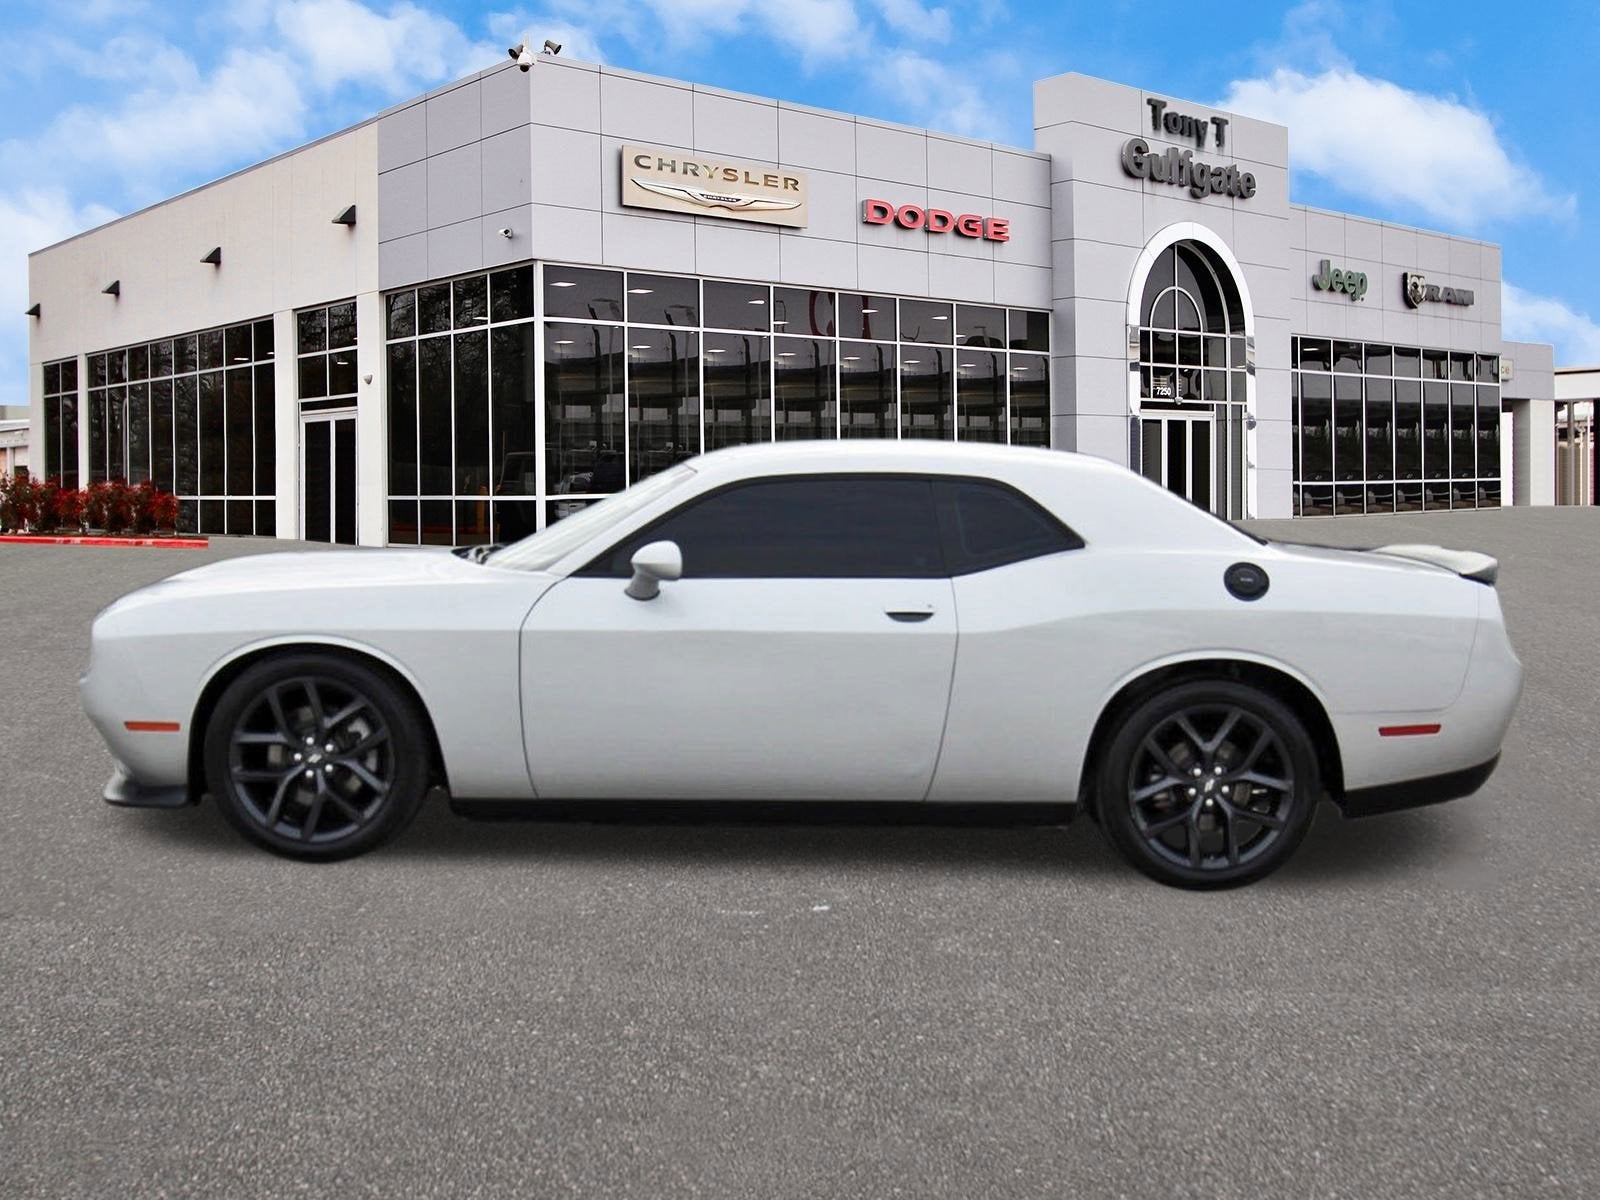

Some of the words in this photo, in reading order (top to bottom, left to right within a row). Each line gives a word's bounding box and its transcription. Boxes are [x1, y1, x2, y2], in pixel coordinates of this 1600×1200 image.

[1147, 98, 1208, 147] Tony
[1211, 117, 1229, 147] T
[634, 154, 800, 191] CHRYSLER
[1121, 138, 1256, 198] Gulfgate
[862, 199, 1009, 242] DODGE
[1312, 259, 1367, 301] Jeep
[1425, 284, 1474, 306] RAM
[1156, 386, 1172, 396] 7250
